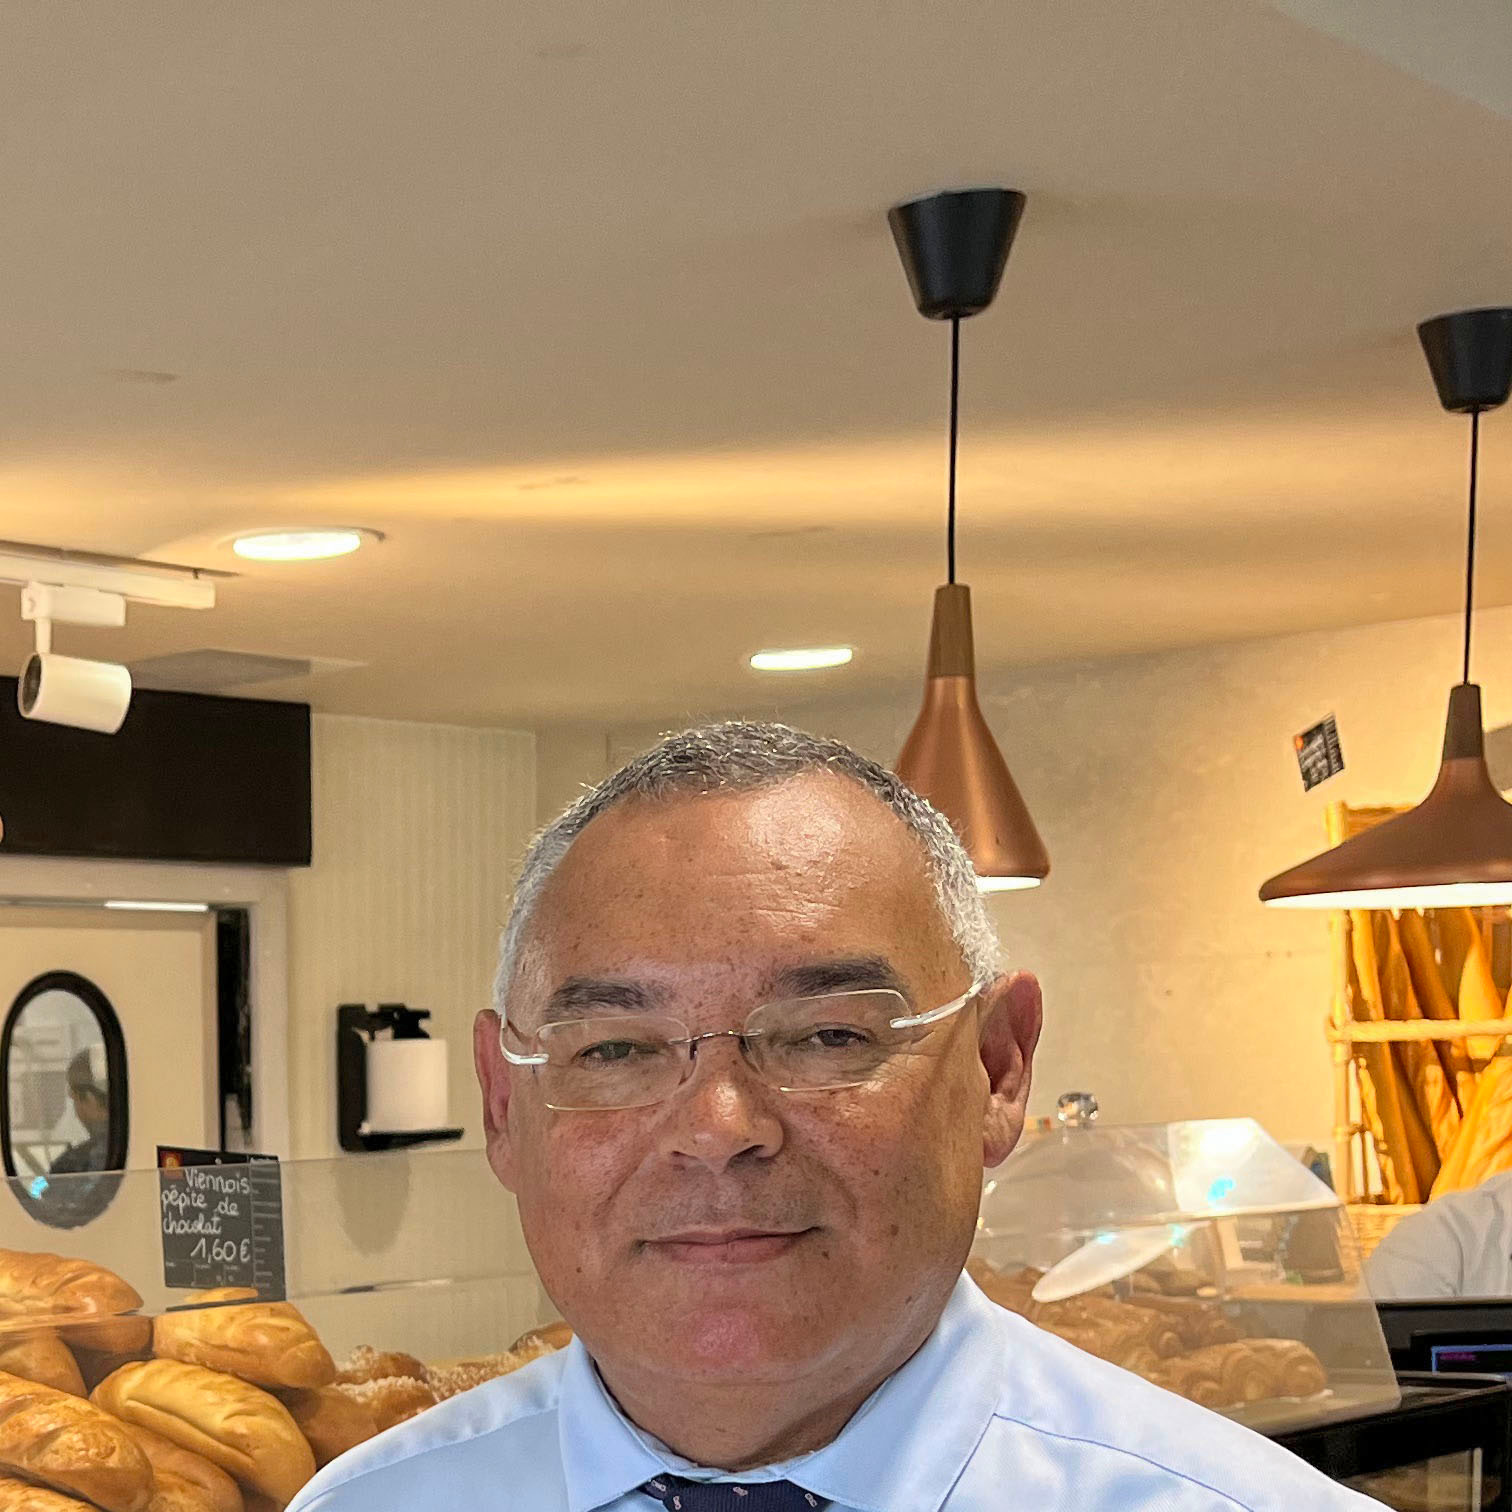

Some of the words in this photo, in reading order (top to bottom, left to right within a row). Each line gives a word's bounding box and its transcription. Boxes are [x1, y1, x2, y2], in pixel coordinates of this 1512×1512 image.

[184, 1169, 251, 1195] Viennois
[216, 1197, 240, 1217] de
[163, 1212, 222, 1235] chocolat
